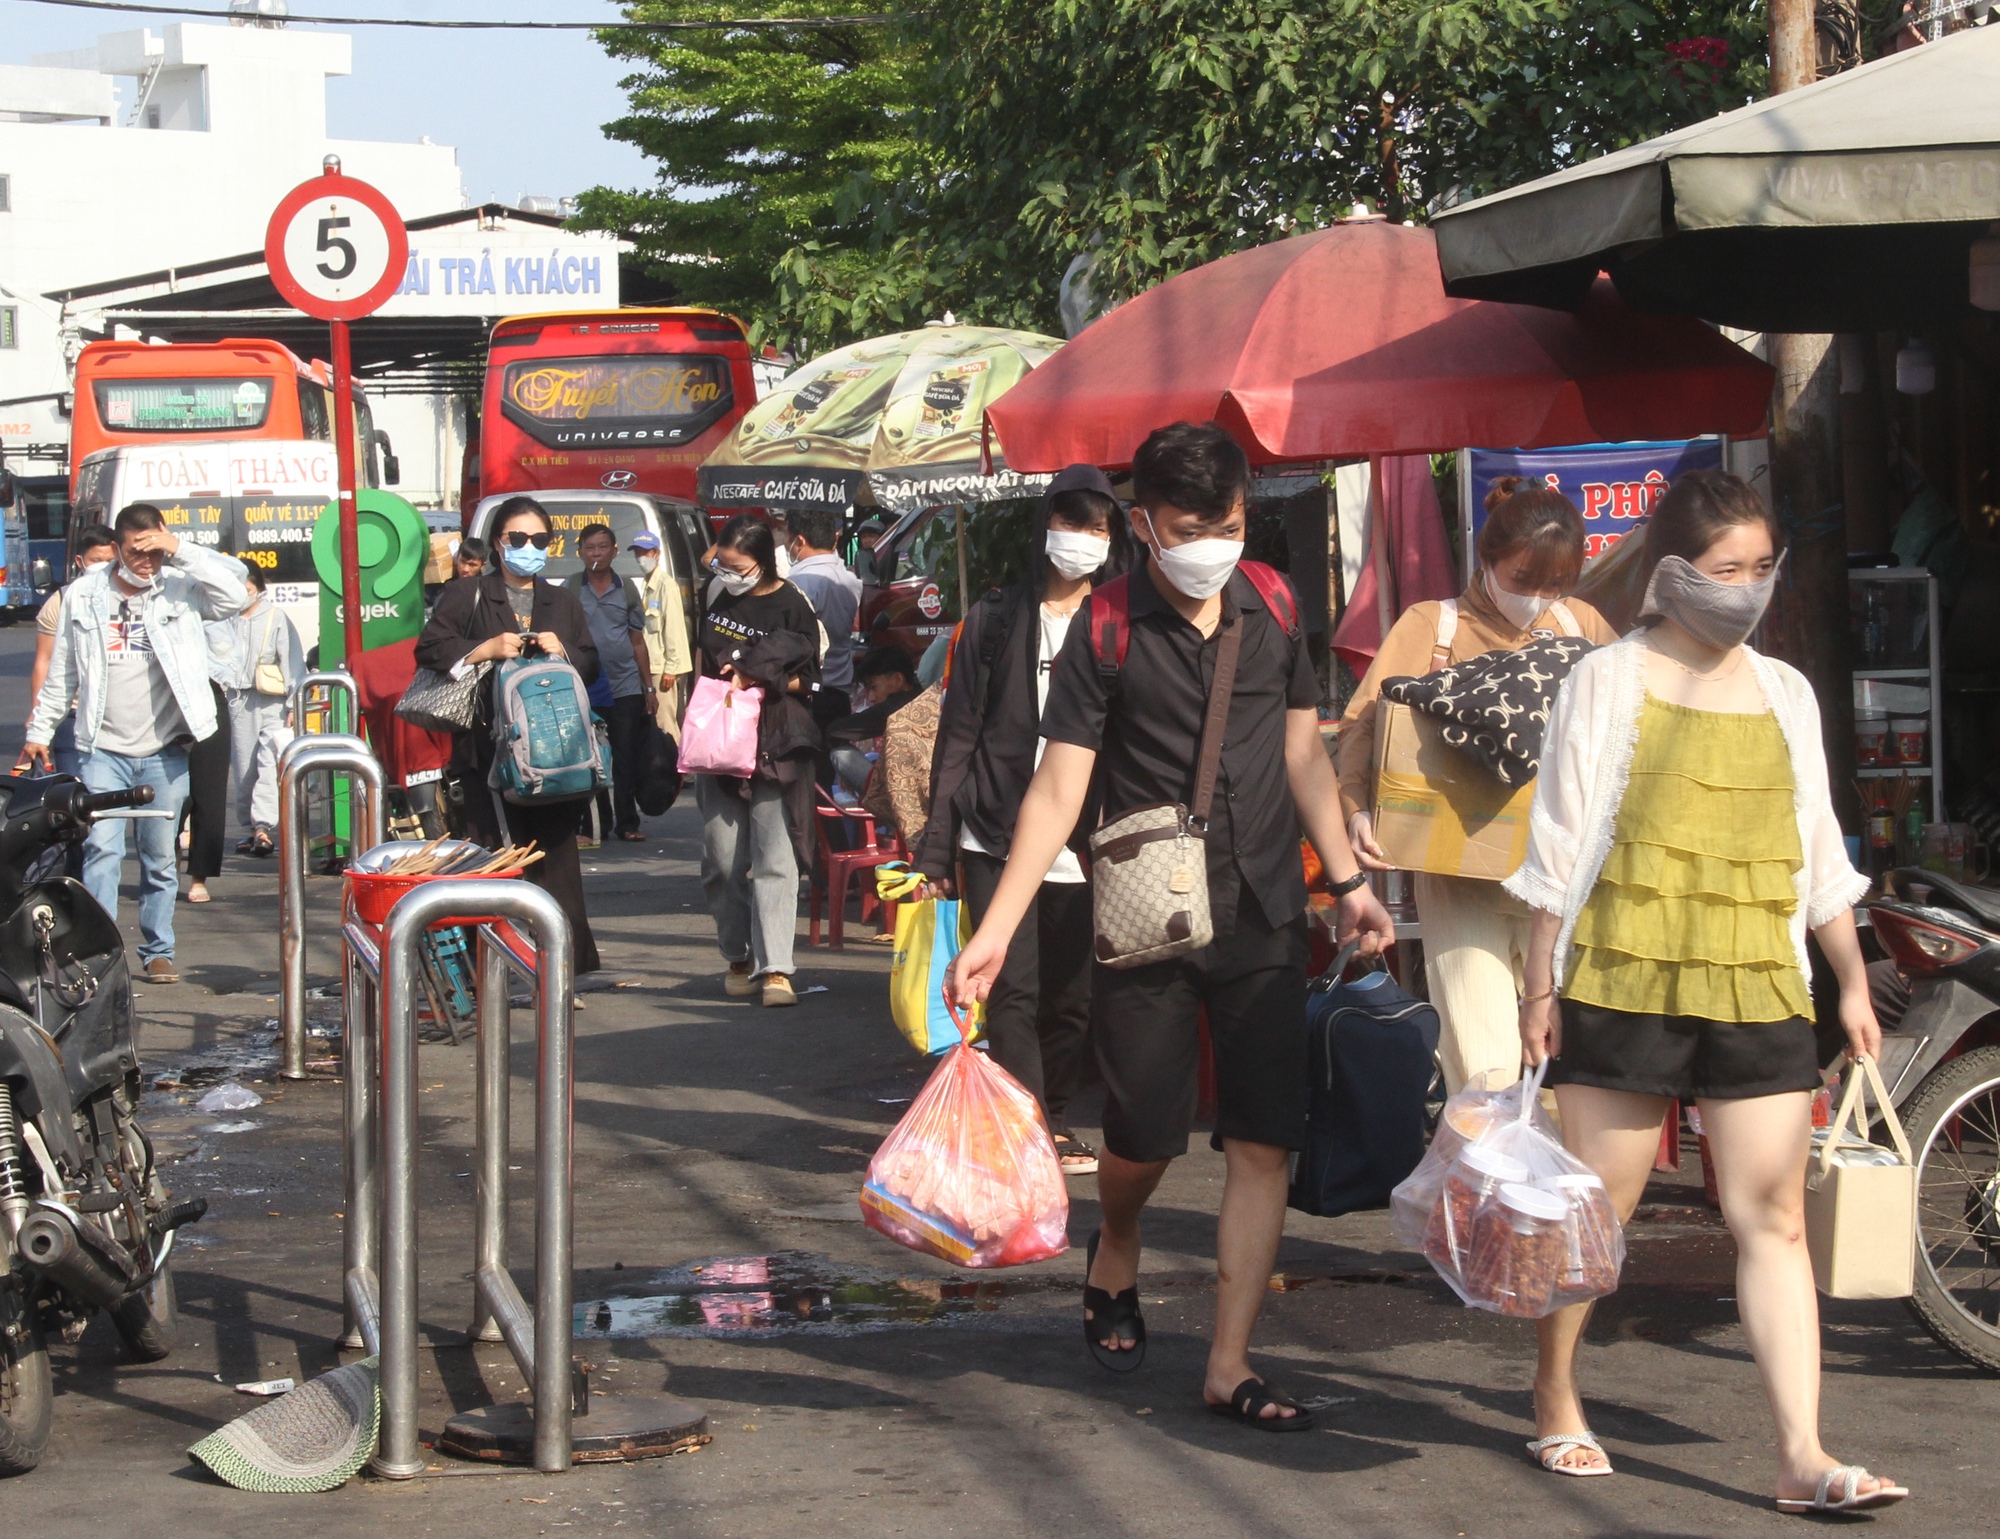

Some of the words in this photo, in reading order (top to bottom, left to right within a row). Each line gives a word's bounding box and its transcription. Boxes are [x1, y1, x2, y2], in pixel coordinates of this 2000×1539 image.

[1765, 165, 1847, 200] VIVA
[1860, 161, 1956, 199] STAR
[316, 216, 357, 280] 5
[395, 249, 430, 295] ÃI
[439, 247, 496, 295] TRẢ
[505, 247, 601, 294] KHÁCH
[513, 367, 620, 420] Tuyết
[557, 429, 682, 442] UNIVERSE
[140, 451, 209, 488] TOÀN
[713, 480, 764, 499] NESCAFÉ
[765, 476, 800, 500] CAFÉ
[799, 478, 825, 502] SỮA
[828, 479, 846, 504] ĐÁ
[1582, 469, 1670, 520] PHÊ
[199, 505, 222, 524] TÂY
[244, 500, 277, 525] QUẦY
[277, 502, 293, 521] VÉ
[550, 514, 570, 530] UNG
[248, 528, 313, 544] 0889.400.5
[707, 611, 769, 637] HARDMO
